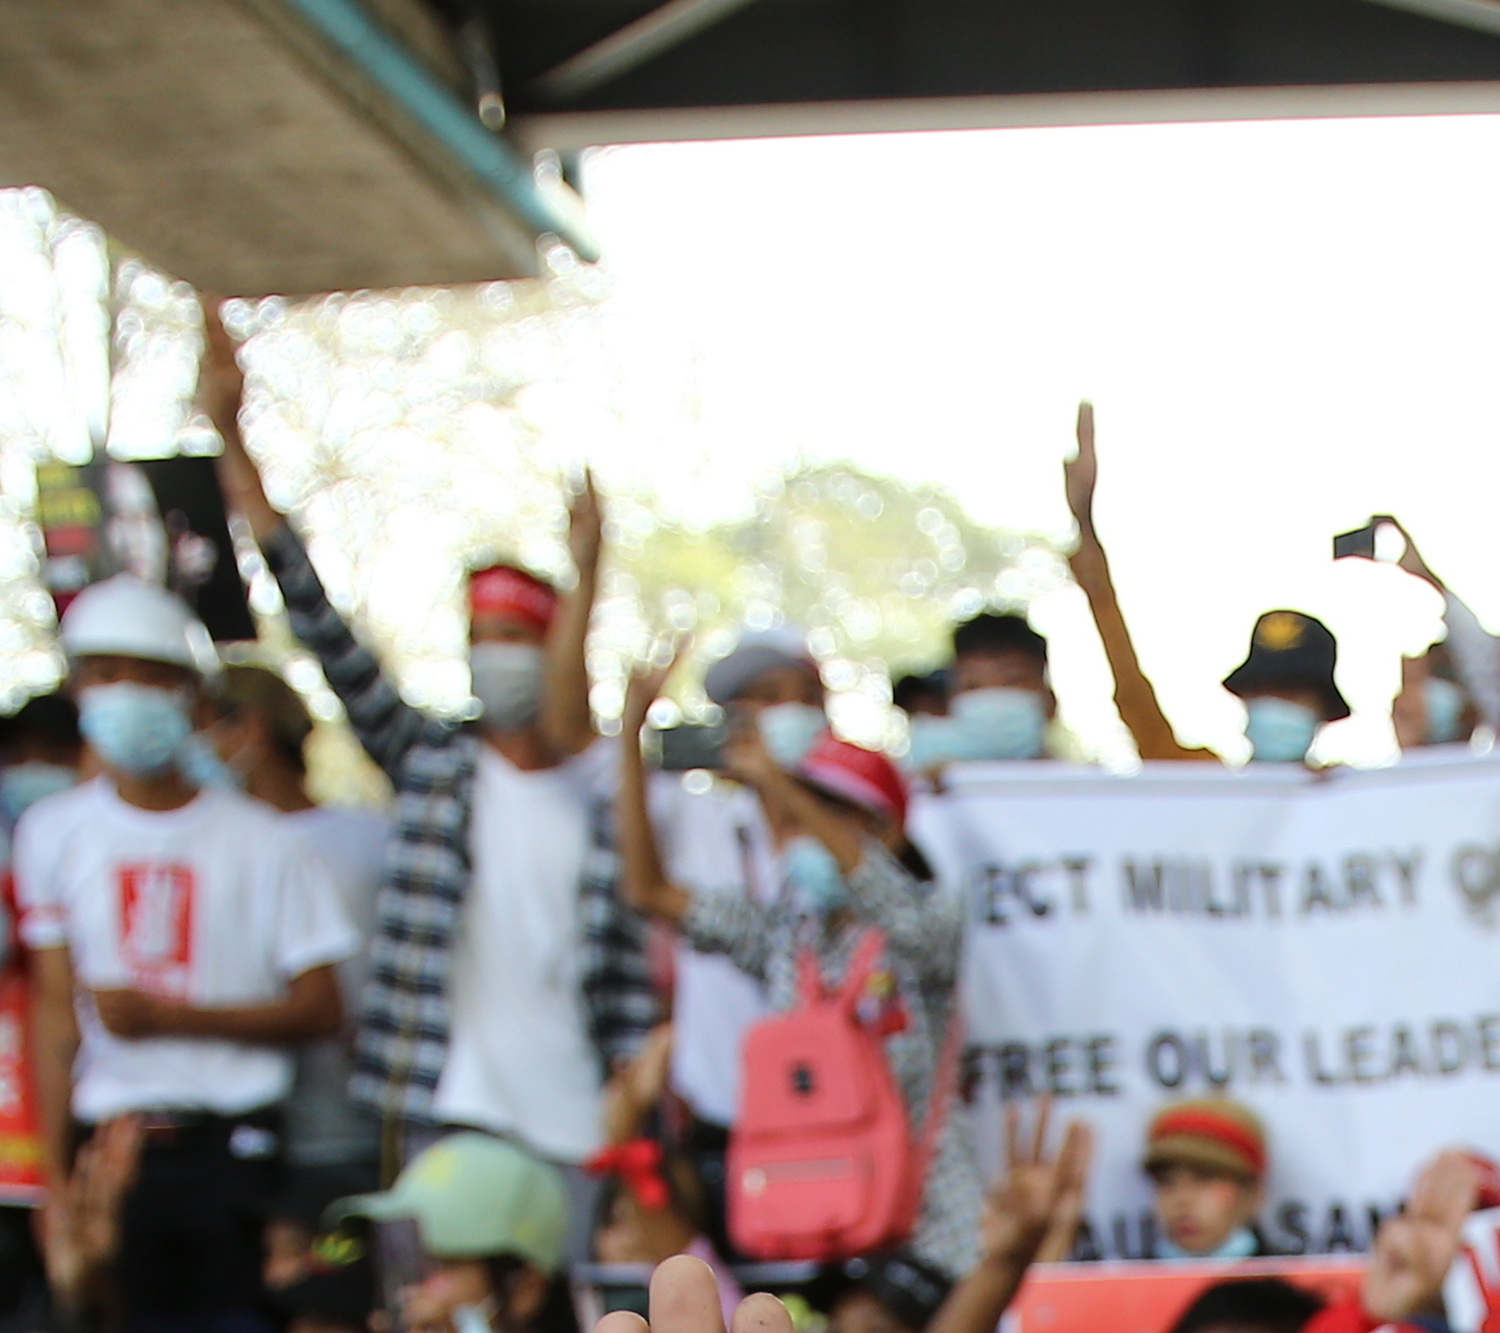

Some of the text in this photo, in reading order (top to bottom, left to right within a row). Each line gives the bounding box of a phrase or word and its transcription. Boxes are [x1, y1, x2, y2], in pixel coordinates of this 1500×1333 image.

[978, 858, 1092, 926] ECT
[962, 1033, 1118, 1102] FREE
[1147, 1028, 1285, 1090] OUR
